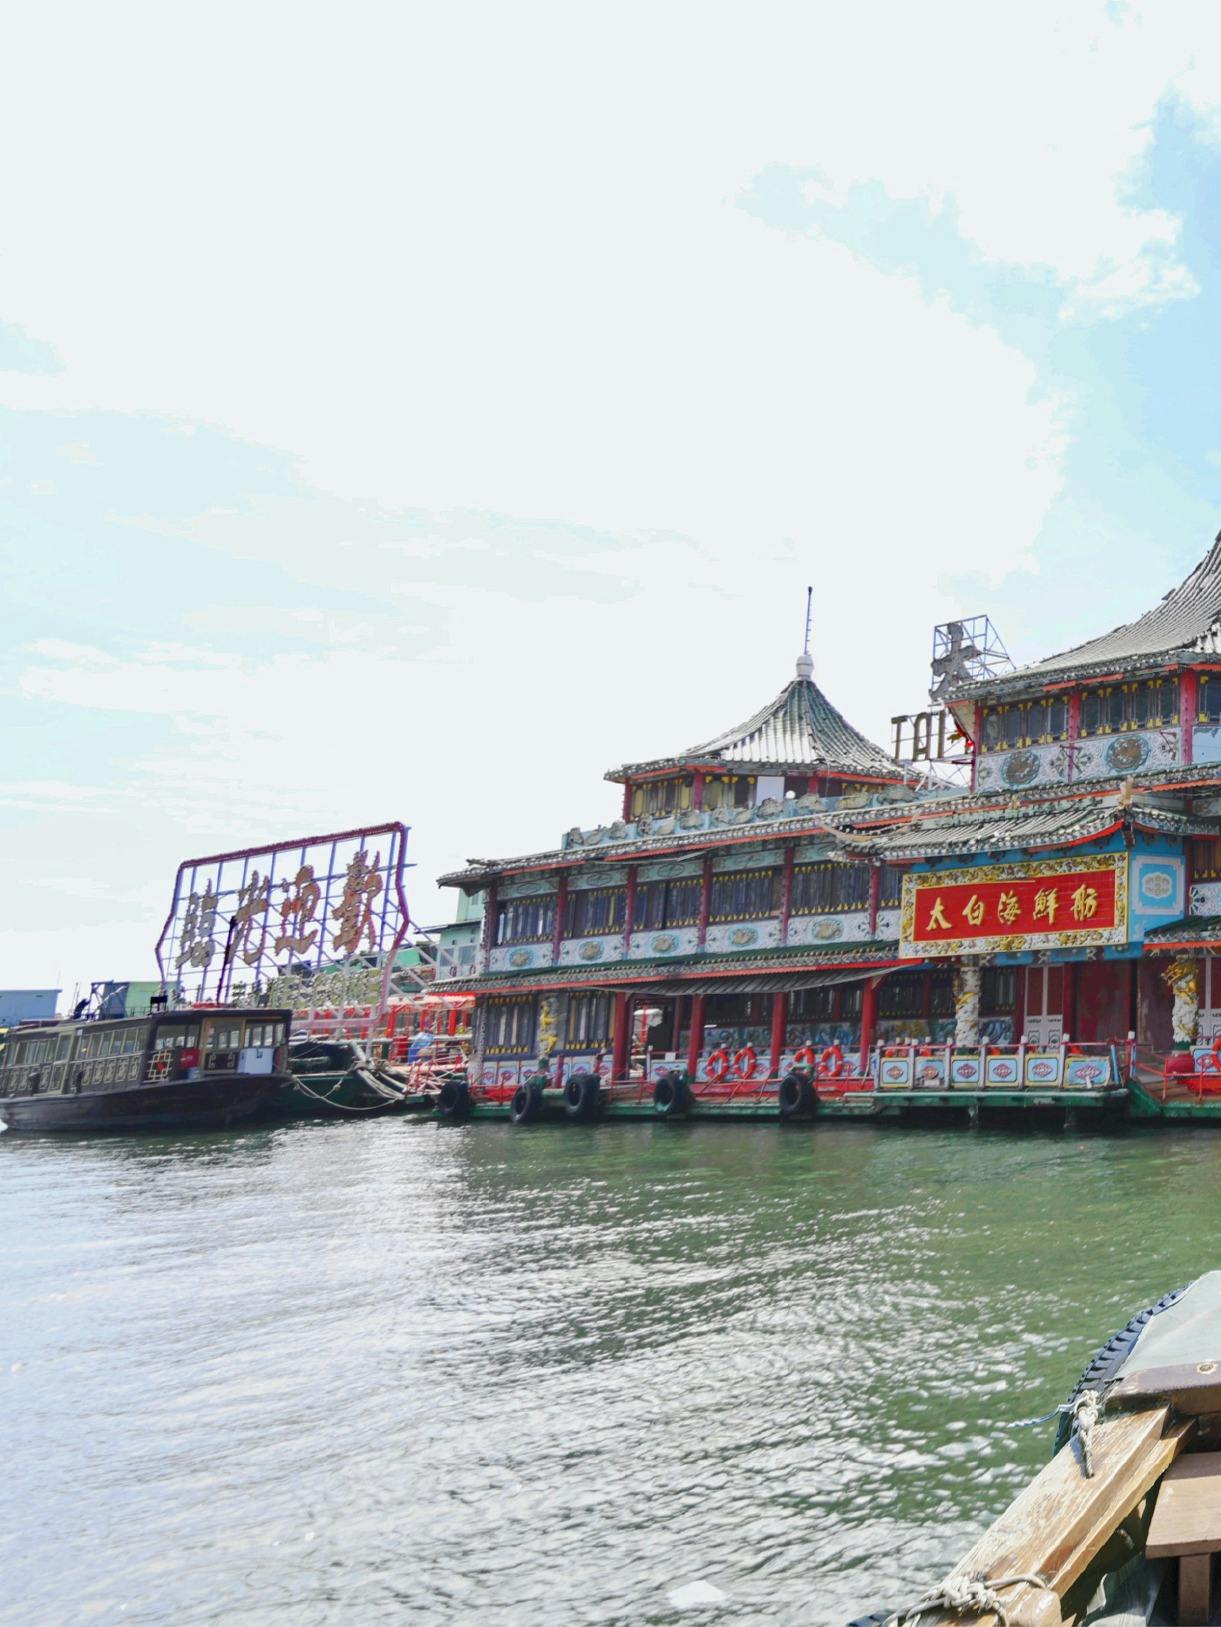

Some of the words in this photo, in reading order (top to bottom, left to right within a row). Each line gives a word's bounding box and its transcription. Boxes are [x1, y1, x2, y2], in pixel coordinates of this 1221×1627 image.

[925, 883, 1099, 932] 太白海鮮舫
